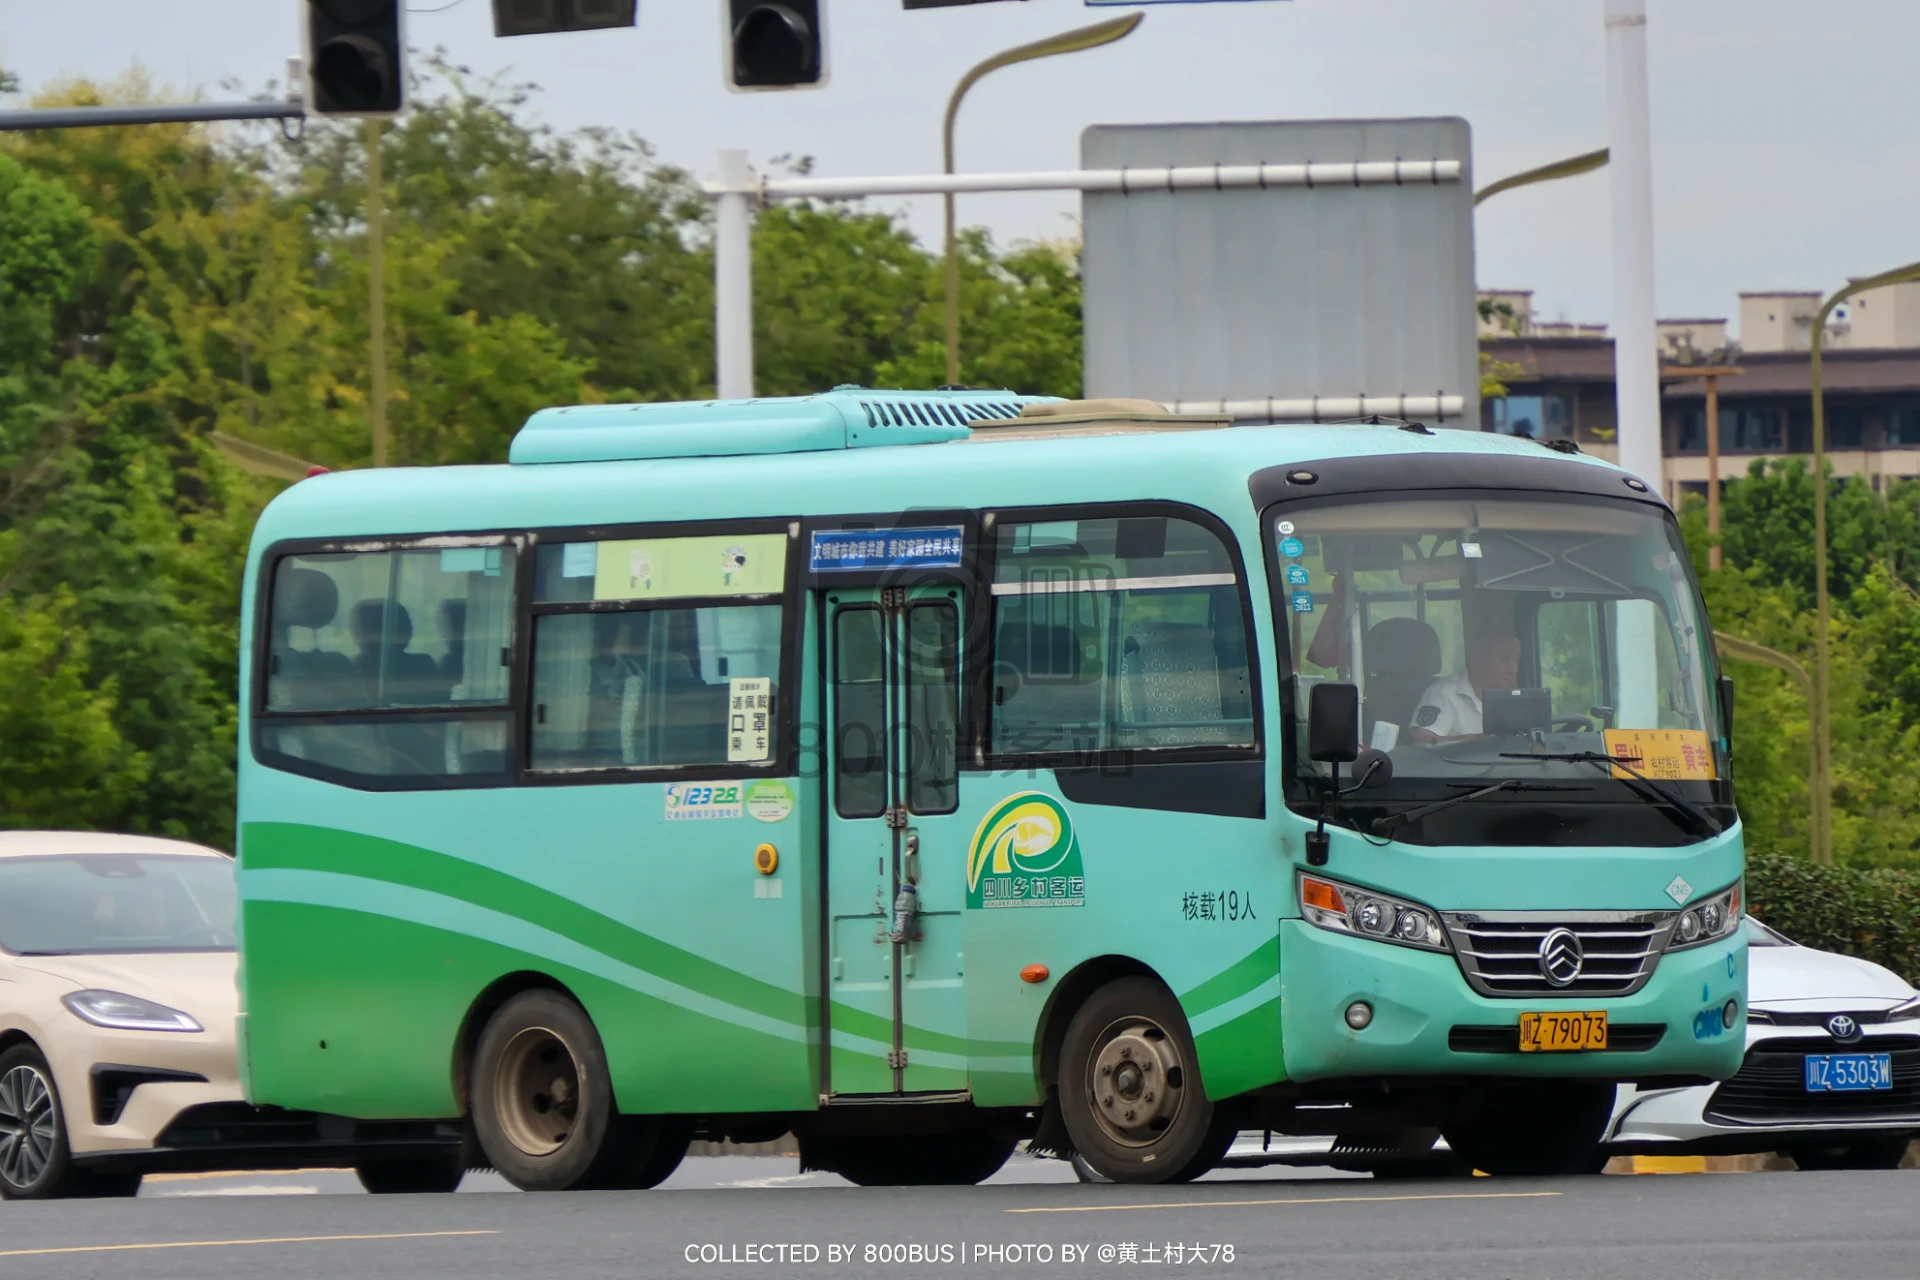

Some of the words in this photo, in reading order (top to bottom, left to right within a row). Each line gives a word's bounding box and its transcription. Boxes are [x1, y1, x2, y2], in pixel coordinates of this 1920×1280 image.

[731, 713, 766, 733] 口罩
[731, 736, 766, 751] 乘车
[983, 876, 1084, 899] 四川乡村客运
[1670, 883, 1689, 897] CNG
[1182, 890, 1257, 921] 核载19人
